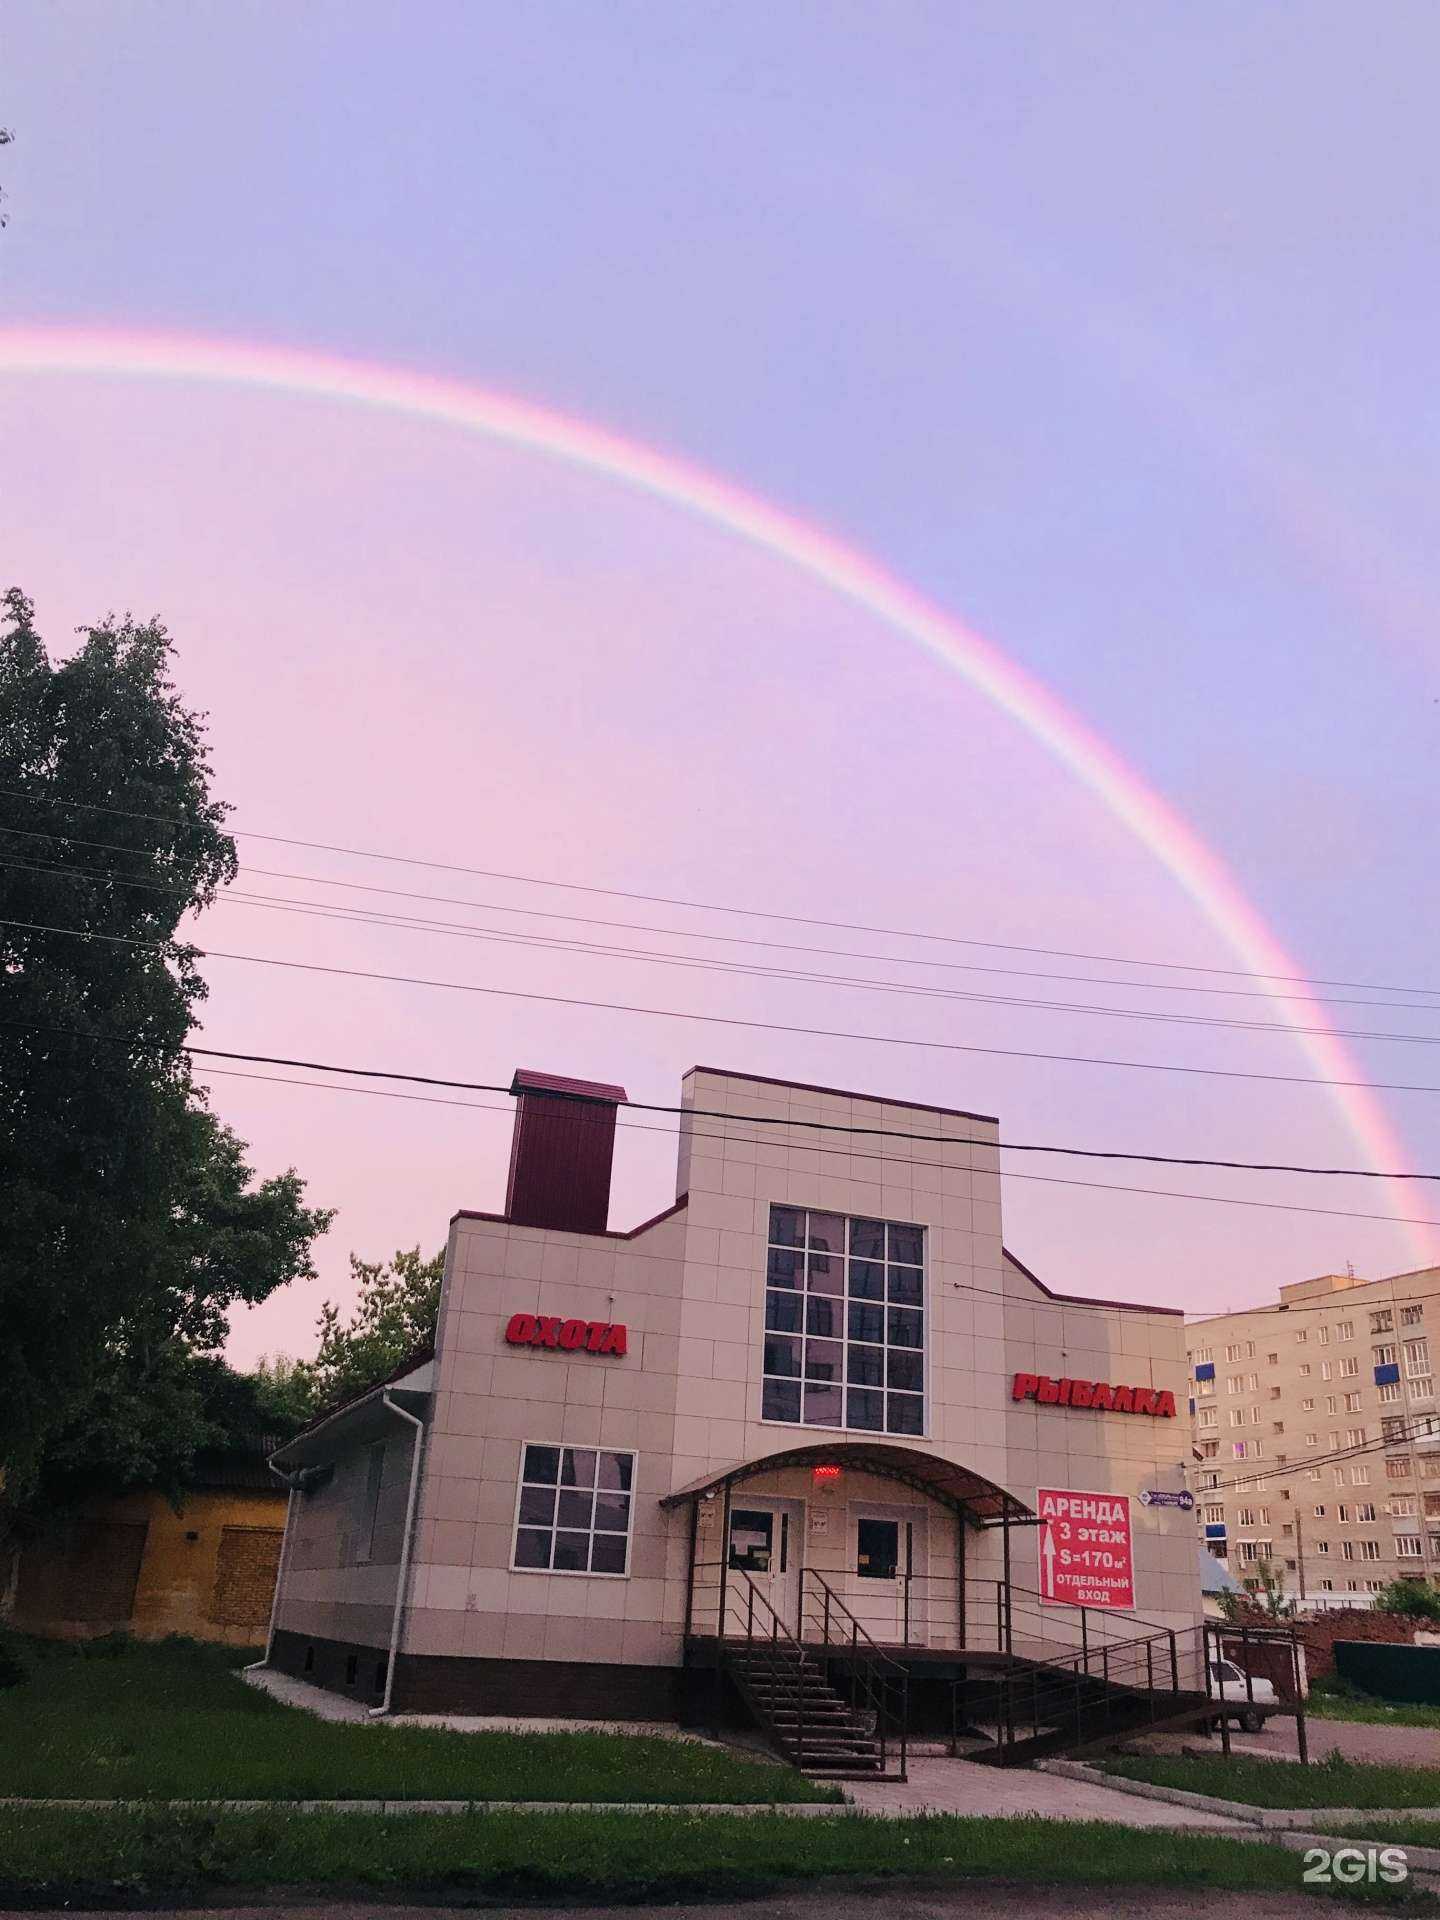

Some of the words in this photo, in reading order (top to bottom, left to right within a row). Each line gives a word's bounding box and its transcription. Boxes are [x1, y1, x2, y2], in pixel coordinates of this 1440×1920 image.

[505, 1313, 627, 1356] ОХОТА
[1013, 1373, 1176, 1417] РЫБАЛКА
[1042, 1497, 1126, 1525] АРЕНДА
[1059, 1522, 1071, 1540] 3
[1078, 1528, 1127, 1544] этаж
[1056, 1574, 1129, 1588] ОТДЕЛЬНЫЙ
[1078, 1589, 1111, 1603] ВХОД
